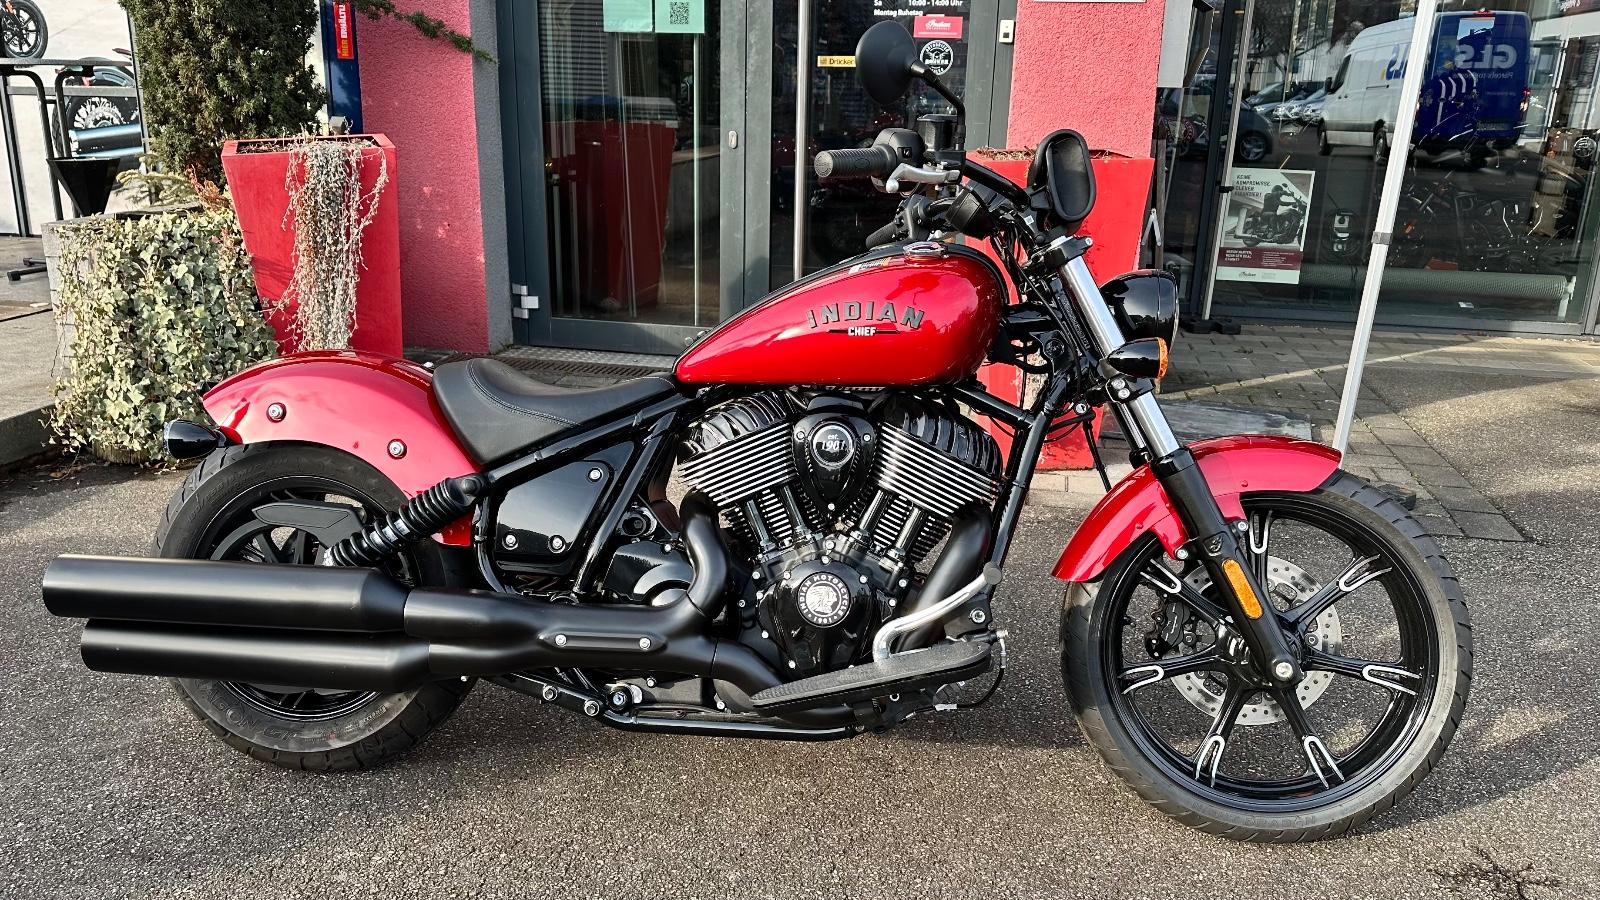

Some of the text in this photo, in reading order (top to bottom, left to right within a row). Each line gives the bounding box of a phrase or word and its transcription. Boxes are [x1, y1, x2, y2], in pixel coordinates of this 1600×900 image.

[873, 9, 924, 18] Montag Ruhetag
[806, 301, 925, 330] INDIAN
[847, 326, 877, 337] CHIEF
[821, 440, 846, 451] 1901
[800, 580, 812, 614] INDIAN
[813, 574, 849, 616] MOTORCYCLE
